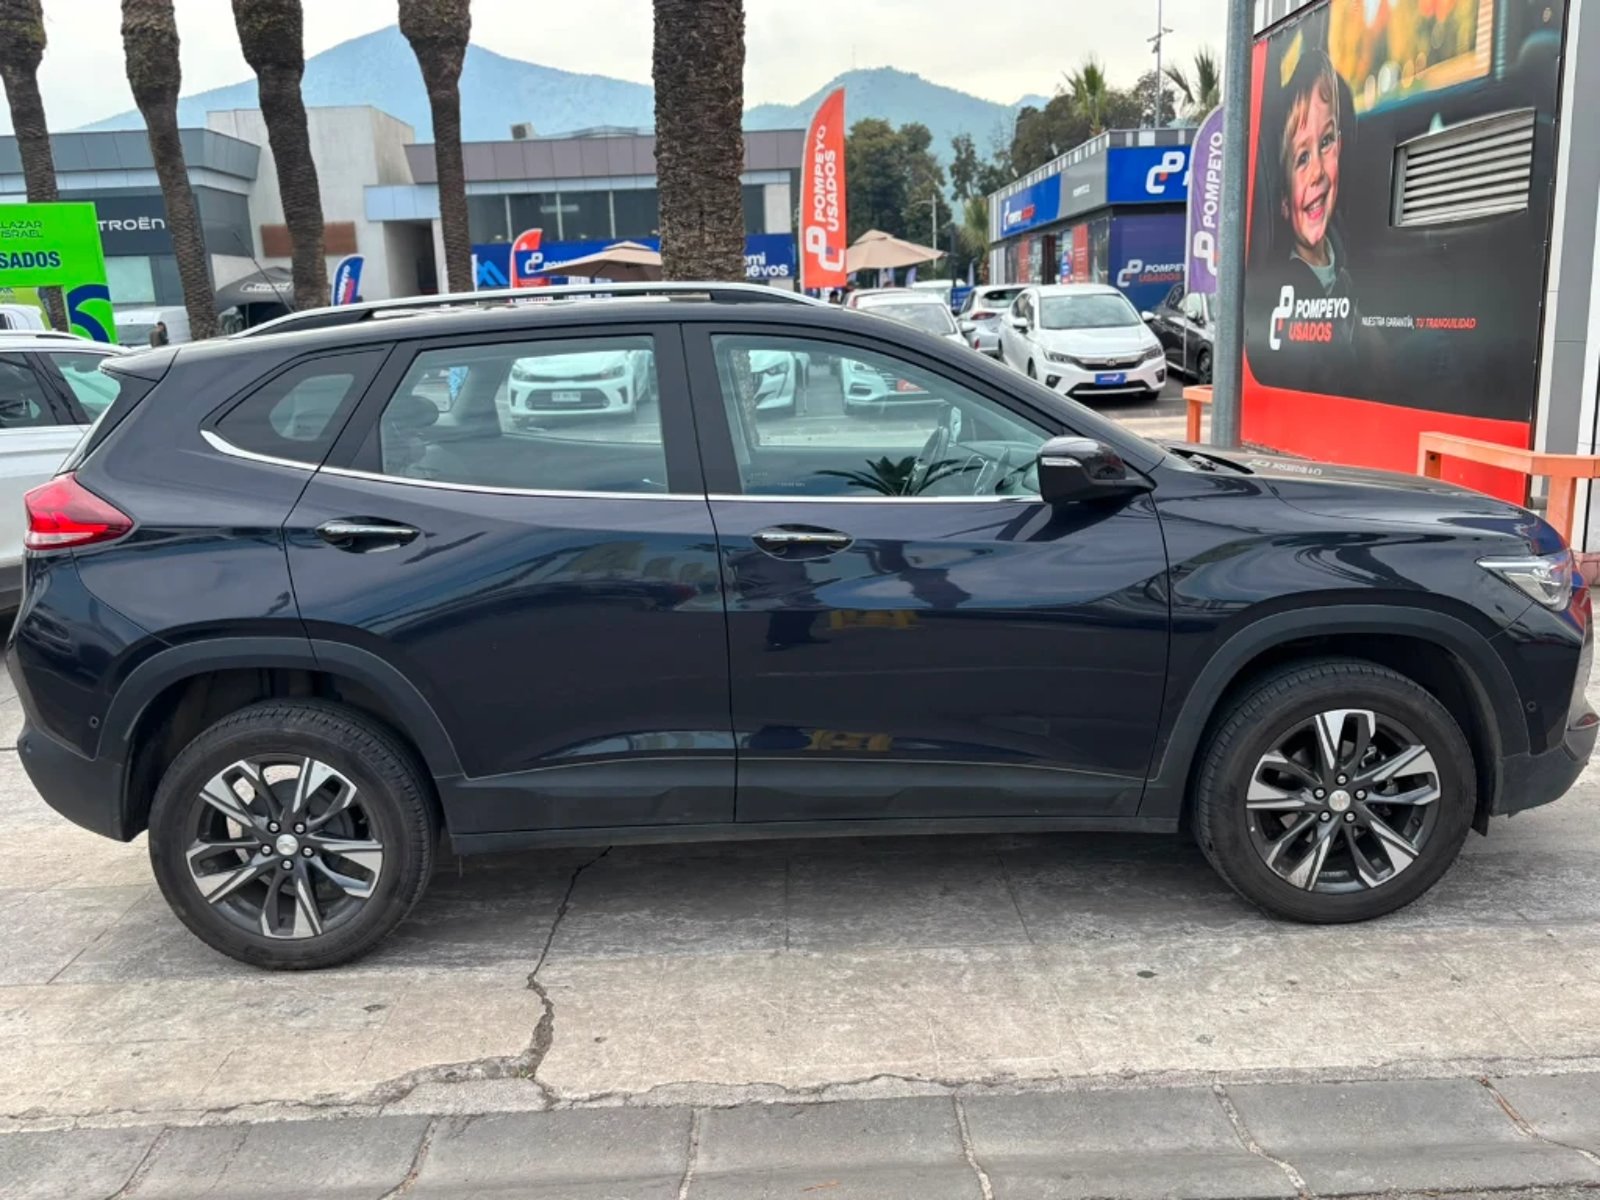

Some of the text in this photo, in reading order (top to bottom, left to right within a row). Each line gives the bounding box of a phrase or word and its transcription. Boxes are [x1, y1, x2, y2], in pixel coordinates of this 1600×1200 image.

[814, 125, 826, 223] POMPEYO
[825, 150, 839, 232] USADOS
[1203, 132, 1223, 228] POMPEYO
[1289, 321, 1333, 342] USADOS
[1295, 297, 1350, 319] POMPEYO
[1426, 317, 1477, 329] TRANQUILIDAD
